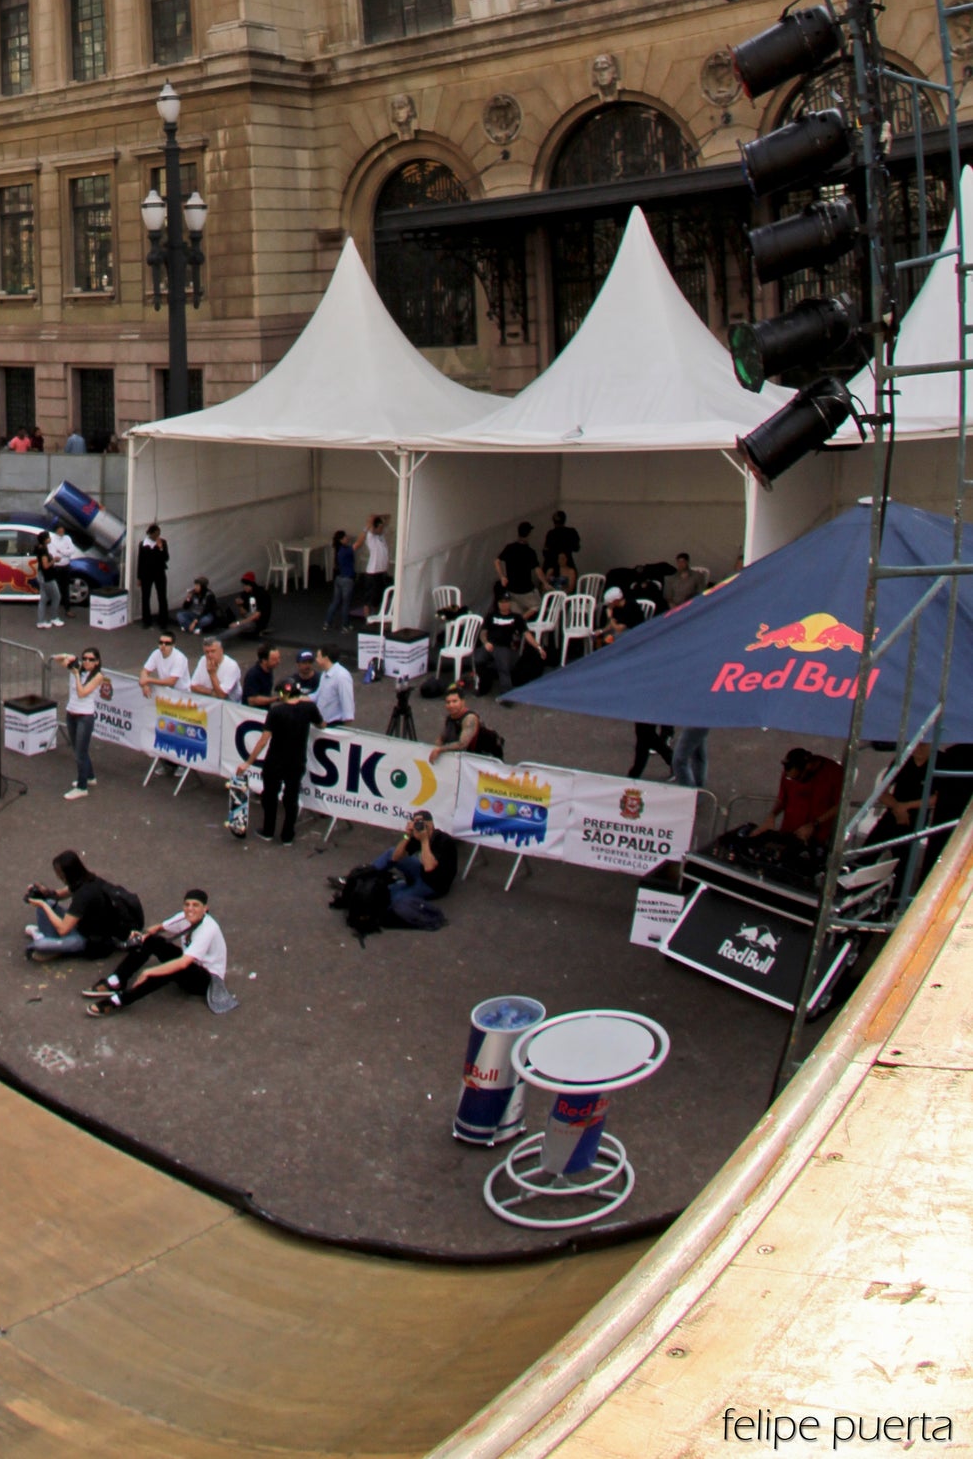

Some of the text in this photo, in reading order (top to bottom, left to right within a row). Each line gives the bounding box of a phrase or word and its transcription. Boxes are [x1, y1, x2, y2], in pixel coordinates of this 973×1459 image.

[710, 658, 797, 693] Red
[100, 713, 132, 731] PAULO
[314, 788, 369, 811] Brasileira
[373, 800, 389, 815] de
[583, 817, 674, 840] PREFEITURA DE
[582, 829, 671, 855] SÃO PAULO
[717, 938, 776, 975] Red Bull
[472, 1064, 500, 1082] Bull
[558, 1100, 594, 1117] Red
